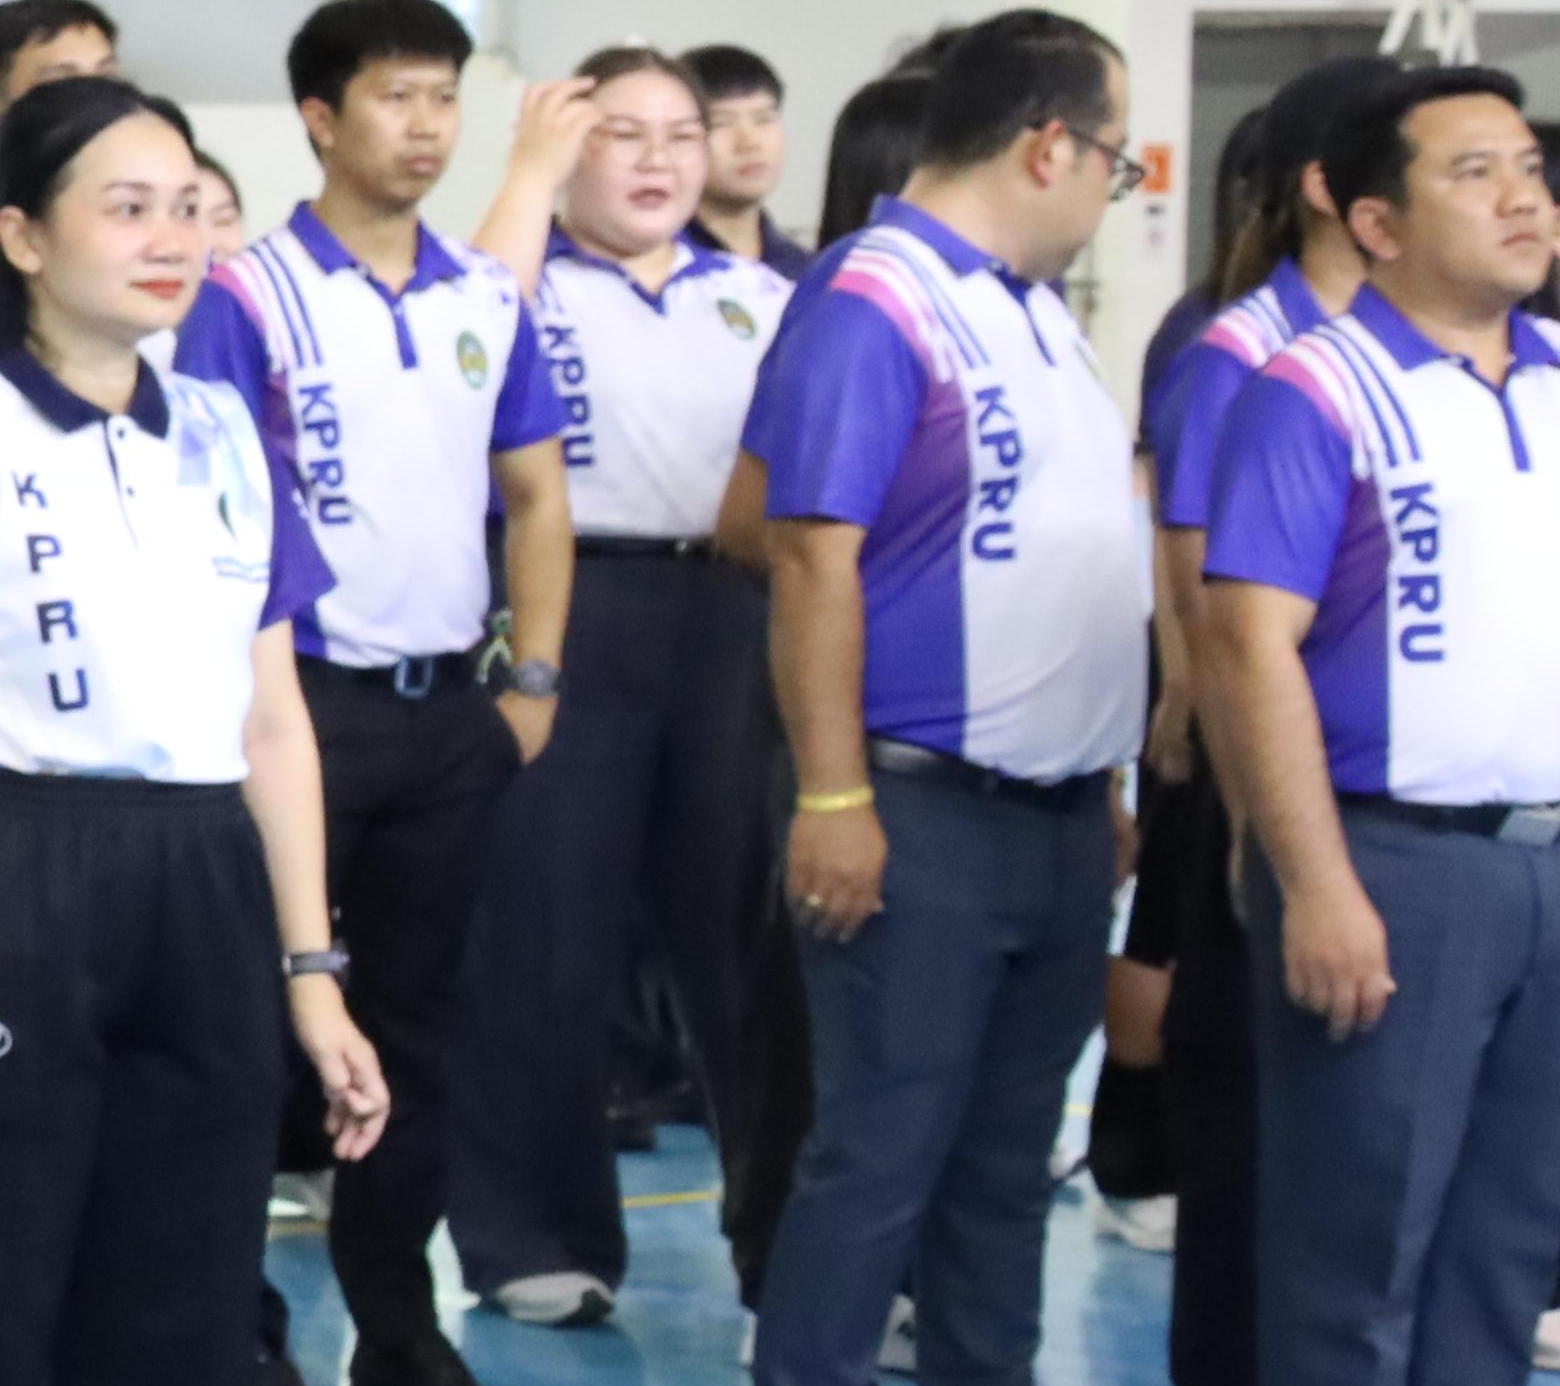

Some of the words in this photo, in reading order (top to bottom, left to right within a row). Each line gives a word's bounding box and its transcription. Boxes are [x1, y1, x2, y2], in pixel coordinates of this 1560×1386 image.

[297, 384, 352, 528] KPRU
[970, 386, 1023, 563] KPRU
[12, 471, 89, 712] KPRU
[1389, 482, 1446, 665] KPRU
